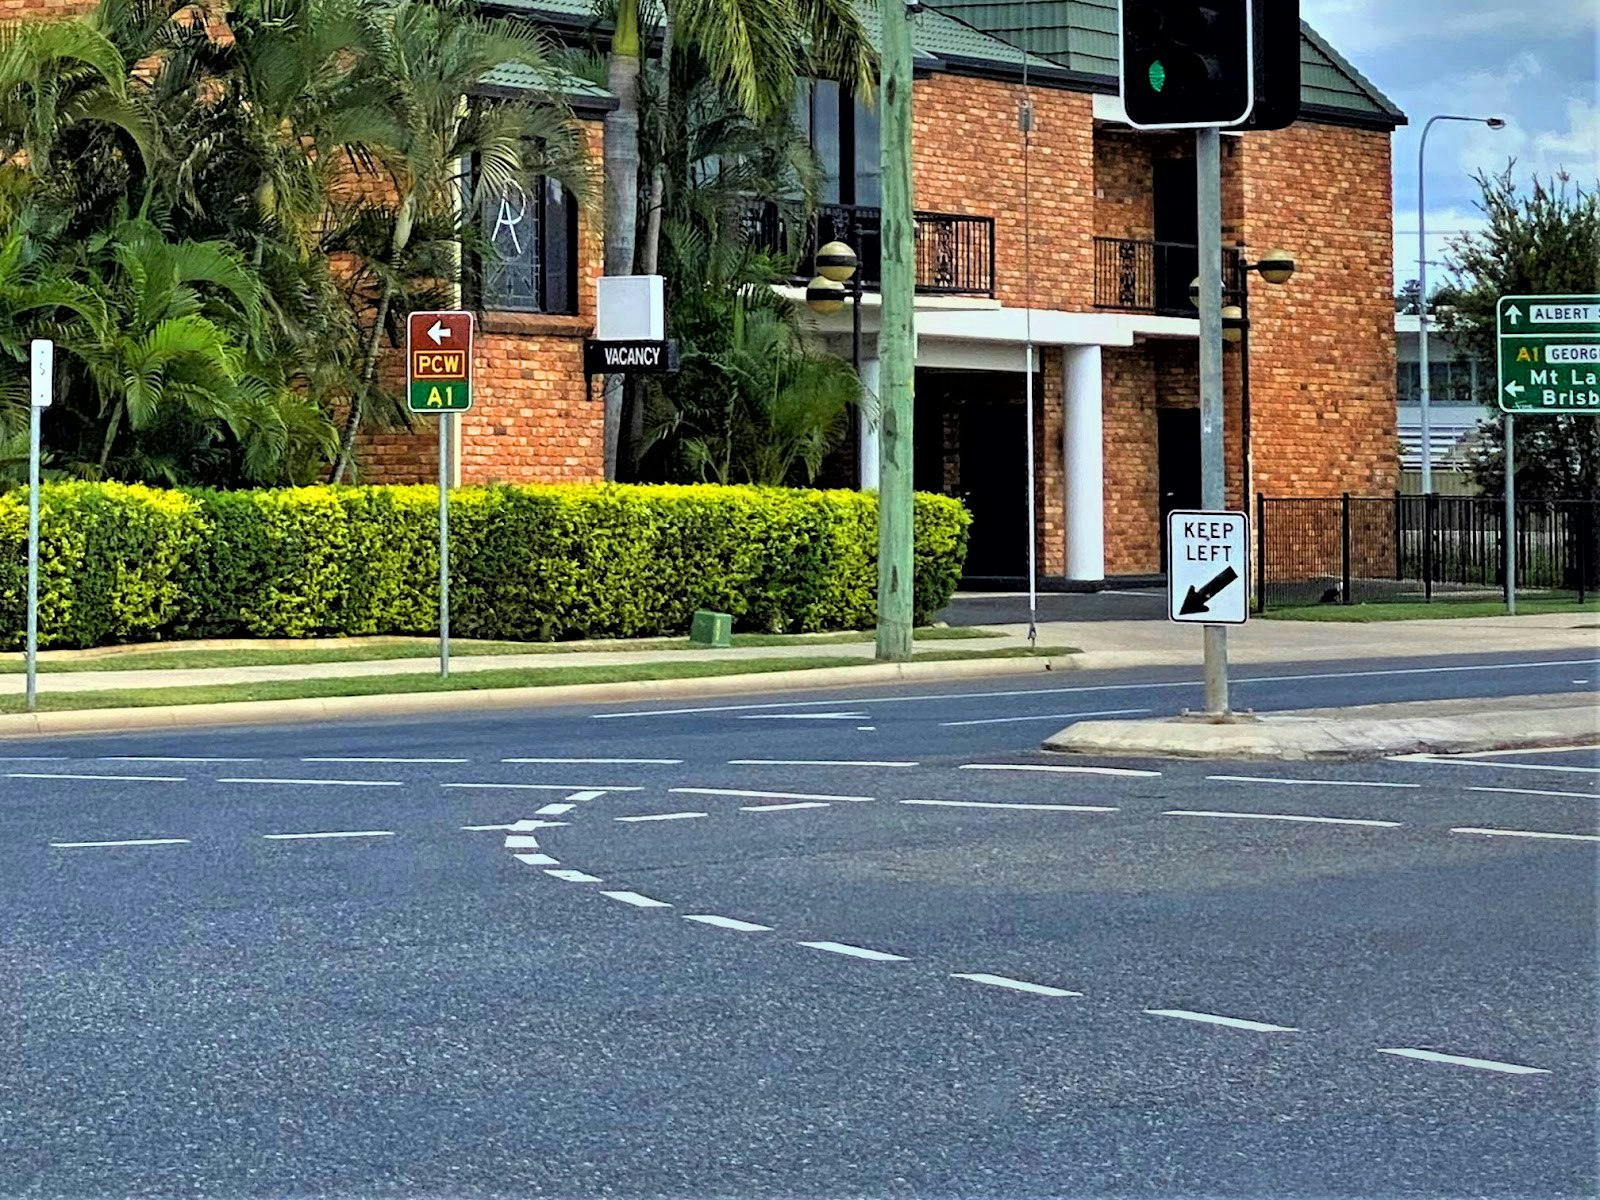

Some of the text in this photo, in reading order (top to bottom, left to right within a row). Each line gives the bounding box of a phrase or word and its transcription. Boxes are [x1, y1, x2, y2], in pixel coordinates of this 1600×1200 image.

[1534, 307, 1590, 320] ALBERT
[604, 347, 660, 366] VACANCY
[1516, 346, 1539, 362] A1
[1551, 347, 1600, 360] GEORG
[418, 355, 460, 374] PCW
[1530, 369, 1559, 386] Mt
[426, 385, 454, 407] A1
[1184, 522, 1234, 539] KEEP
[1186, 545, 1232, 562] LEFT
